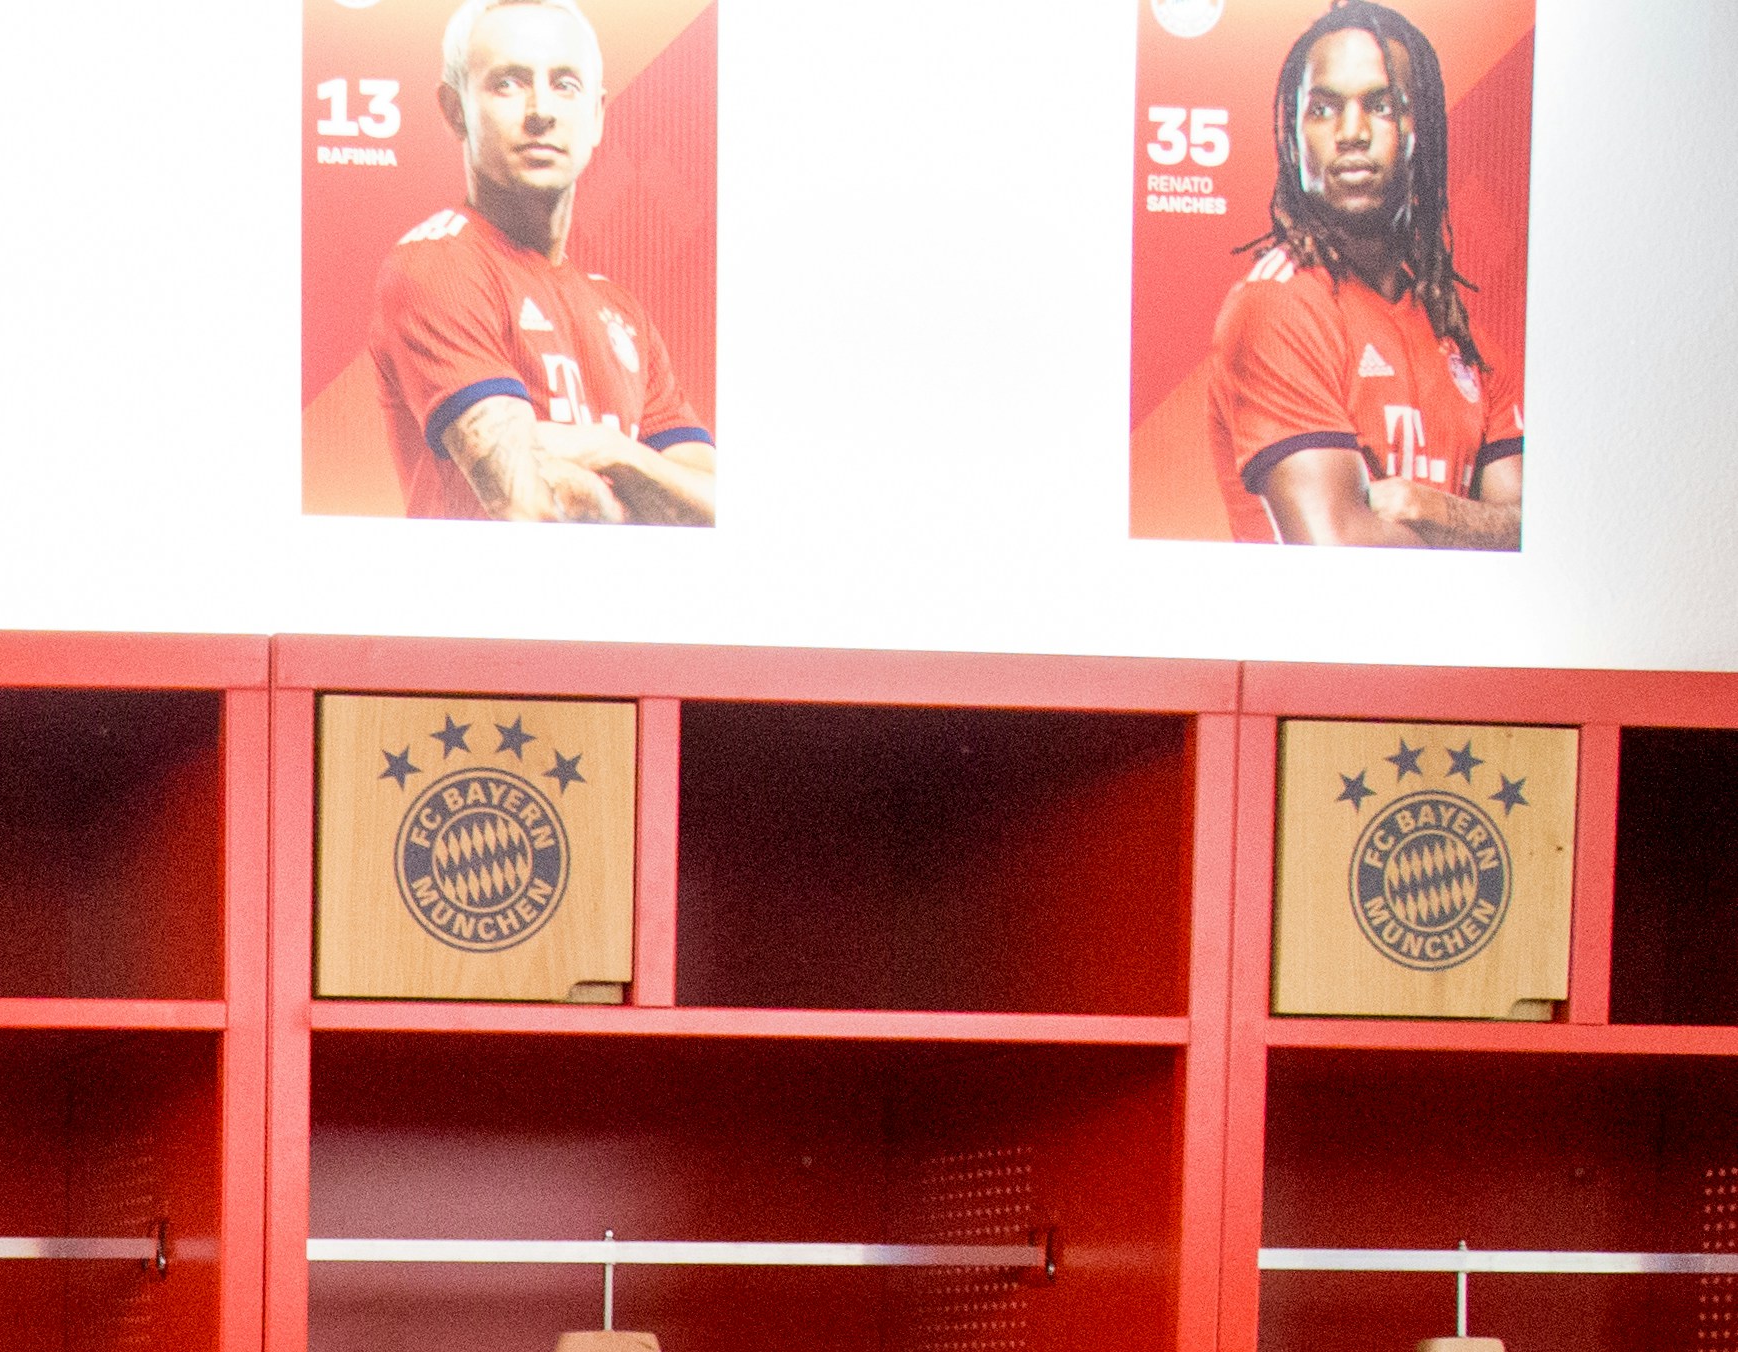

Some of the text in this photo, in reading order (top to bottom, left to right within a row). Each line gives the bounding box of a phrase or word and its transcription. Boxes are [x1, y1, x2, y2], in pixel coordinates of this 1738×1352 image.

[318, 78, 400, 138] 13
[1148, 106, 1229, 166] 35
[318, 146, 397, 165] RAFINHA
[1148, 175, 1213, 193] RENATO
[1147, 194, 1226, 214] SANCHES
[410, 782, 555, 851] FC BAYERN
[1363, 804, 1500, 871] FC BAYERN
